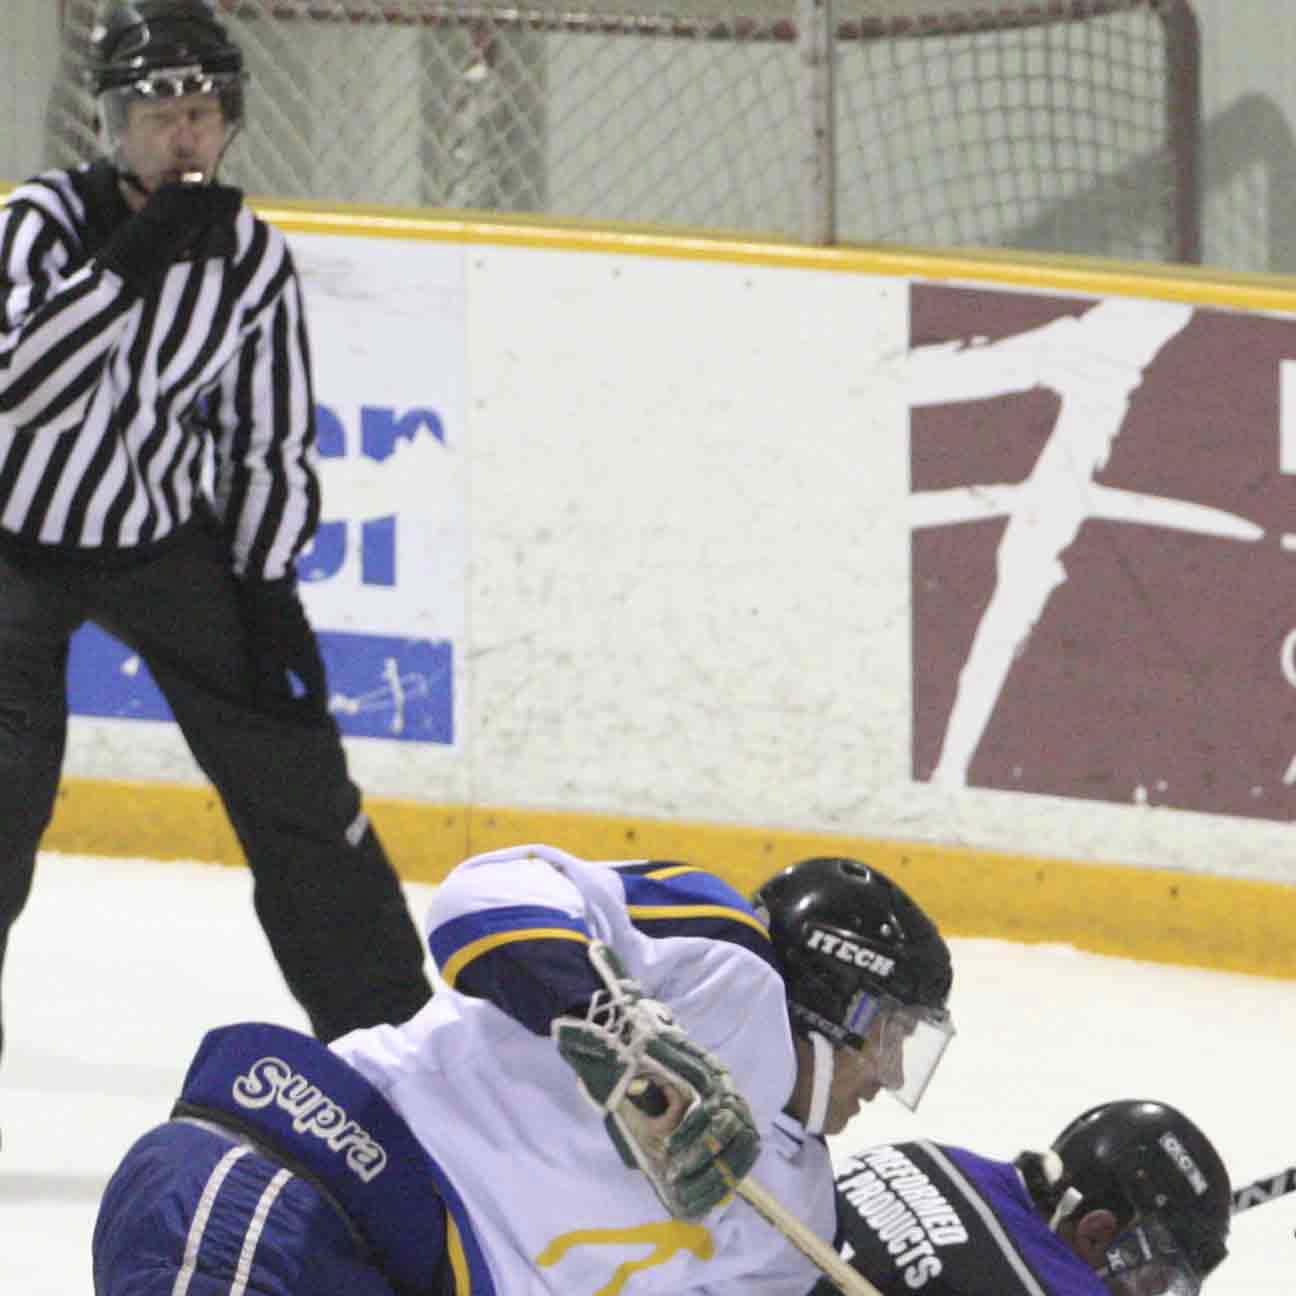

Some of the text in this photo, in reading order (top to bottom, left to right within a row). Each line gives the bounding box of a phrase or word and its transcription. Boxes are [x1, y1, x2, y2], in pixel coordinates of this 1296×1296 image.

[807, 929, 895, 977] ITECH
[232, 1056, 388, 1184] Supra
[836, 1169, 943, 1289] PRODUCTS
